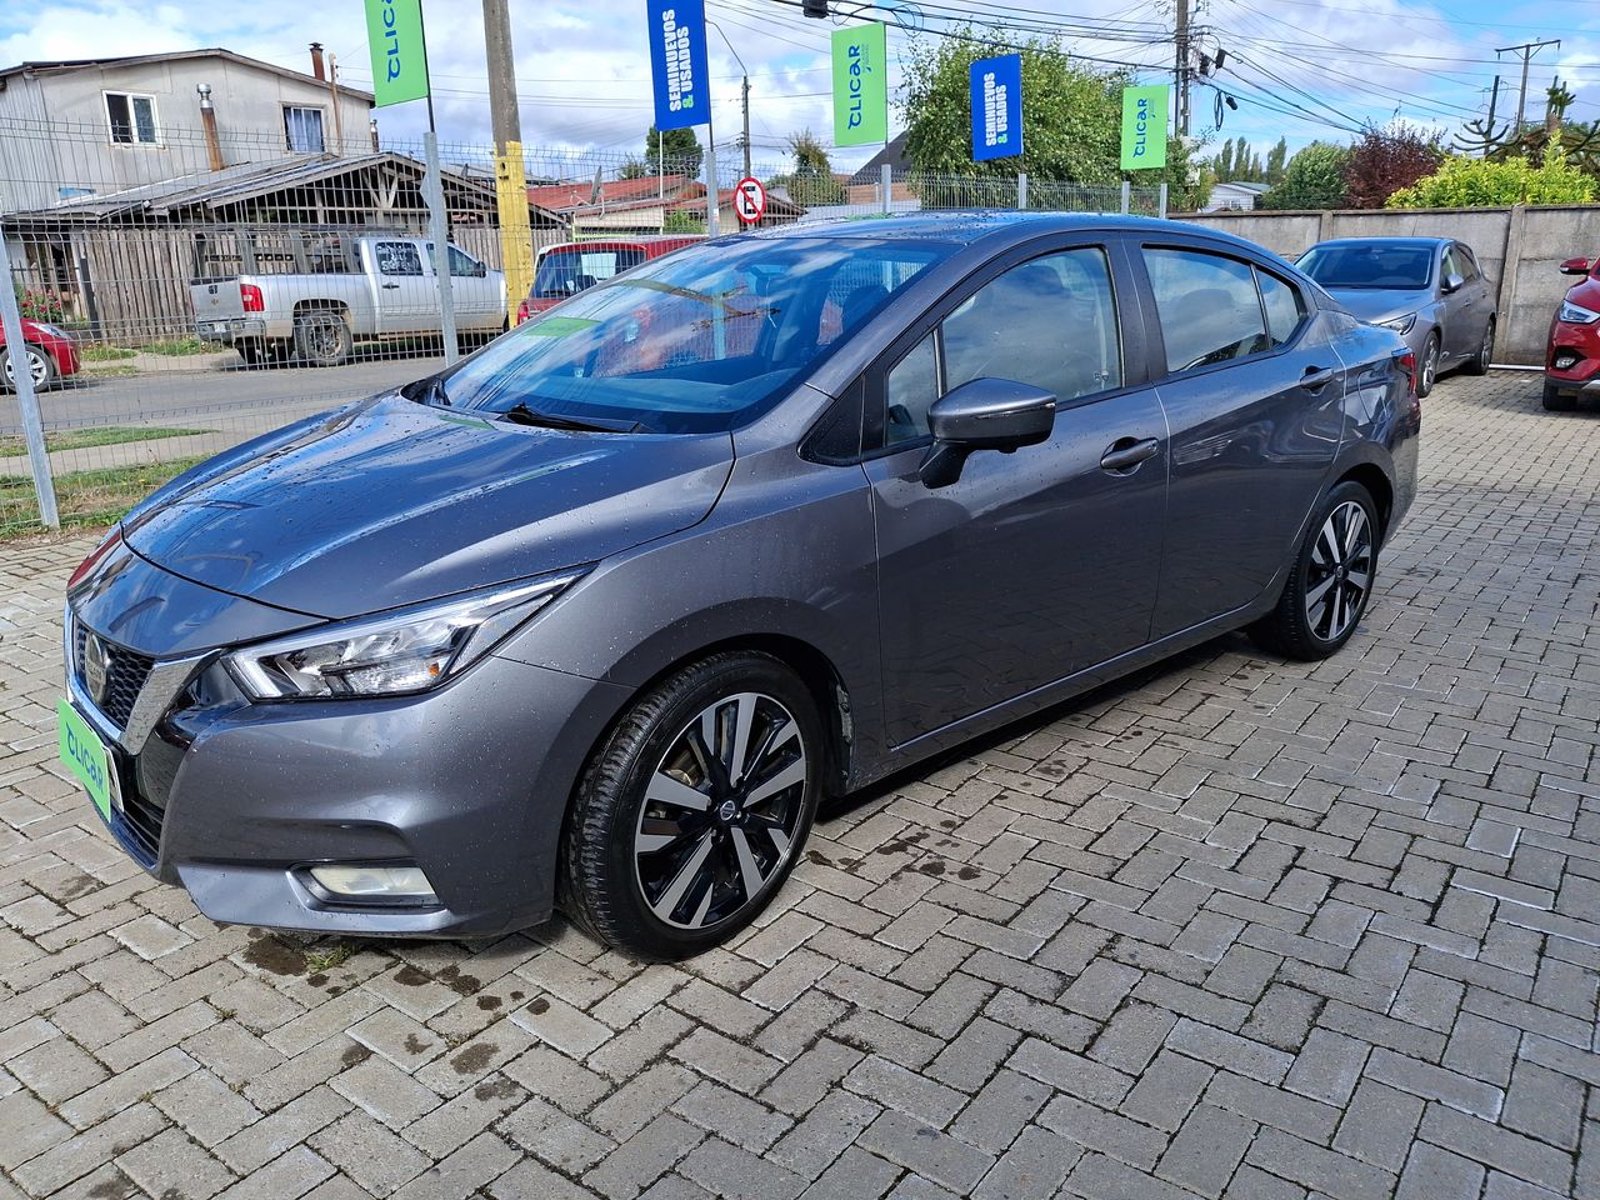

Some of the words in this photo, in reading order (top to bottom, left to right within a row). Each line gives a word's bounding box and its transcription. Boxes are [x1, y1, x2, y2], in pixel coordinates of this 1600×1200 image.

[382, 0, 400, 83] CLIC
[662, 9, 682, 112] SEMINUEVOS
[676, 26, 693, 92] USADOS
[682, 94, 694, 109] &
[983, 72, 997, 147] SEMINUEVOS
[995, 84, 1008, 132] USADOS
[997, 133, 1008, 144] &
